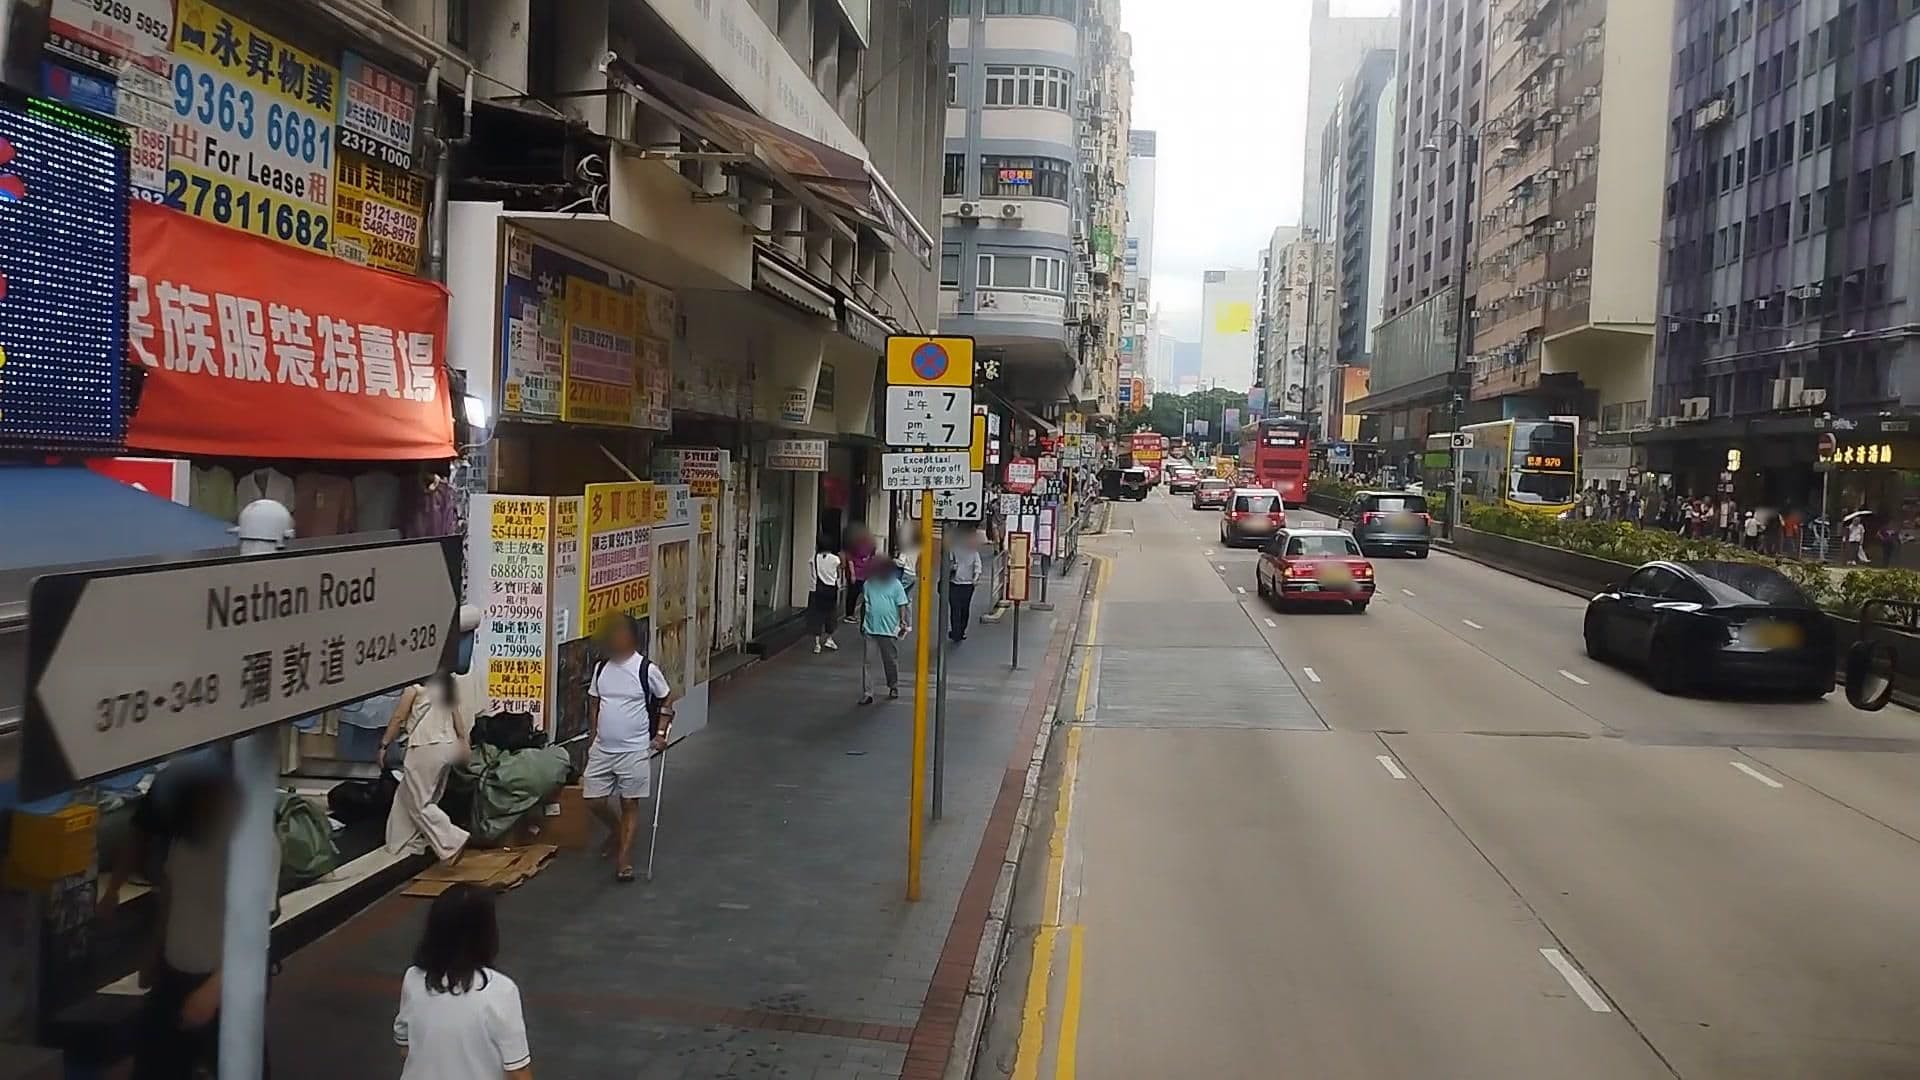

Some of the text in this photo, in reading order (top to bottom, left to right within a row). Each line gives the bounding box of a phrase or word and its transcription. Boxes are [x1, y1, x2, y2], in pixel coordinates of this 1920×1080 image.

[136, 12, 169, 42] 5952
[175, 64, 255, 139] 9363
[268, 103, 330, 169] 6681
[341, 131, 377, 156] 2312
[381, 146, 411, 170] 1000
[171, 123, 198, 163] 出
[205, 136, 240, 175] For
[248, 152, 305, 197] Lease
[308, 172, 328, 206] 租
[165, 169, 329, 250] 27811682
[365, 202, 418, 231] 9121-8108
[363, 217, 416, 245] 5486-8978
[904, 400, 928, 411] 上午
[942, 392, 956, 411] 7
[904, 432, 928, 442] 下午
[907, 421, 955, 442] pm 7
[892, 464, 960, 474] pick up/drop off
[903, 456, 932, 464] Except
[1544, 458, 1561, 467] 970
[956, 501, 977, 517] 12
[492, 526, 546, 539] 55444427
[490, 564, 544, 579] 68888753
[206, 568, 376, 630] Nathan Road
[588, 587, 620, 615] 2770
[489, 604, 543, 619] 92799996
[489, 644, 542, 657] 92799996
[240, 635, 347, 710] 彌敦道
[489, 685, 542, 697] 55444427
